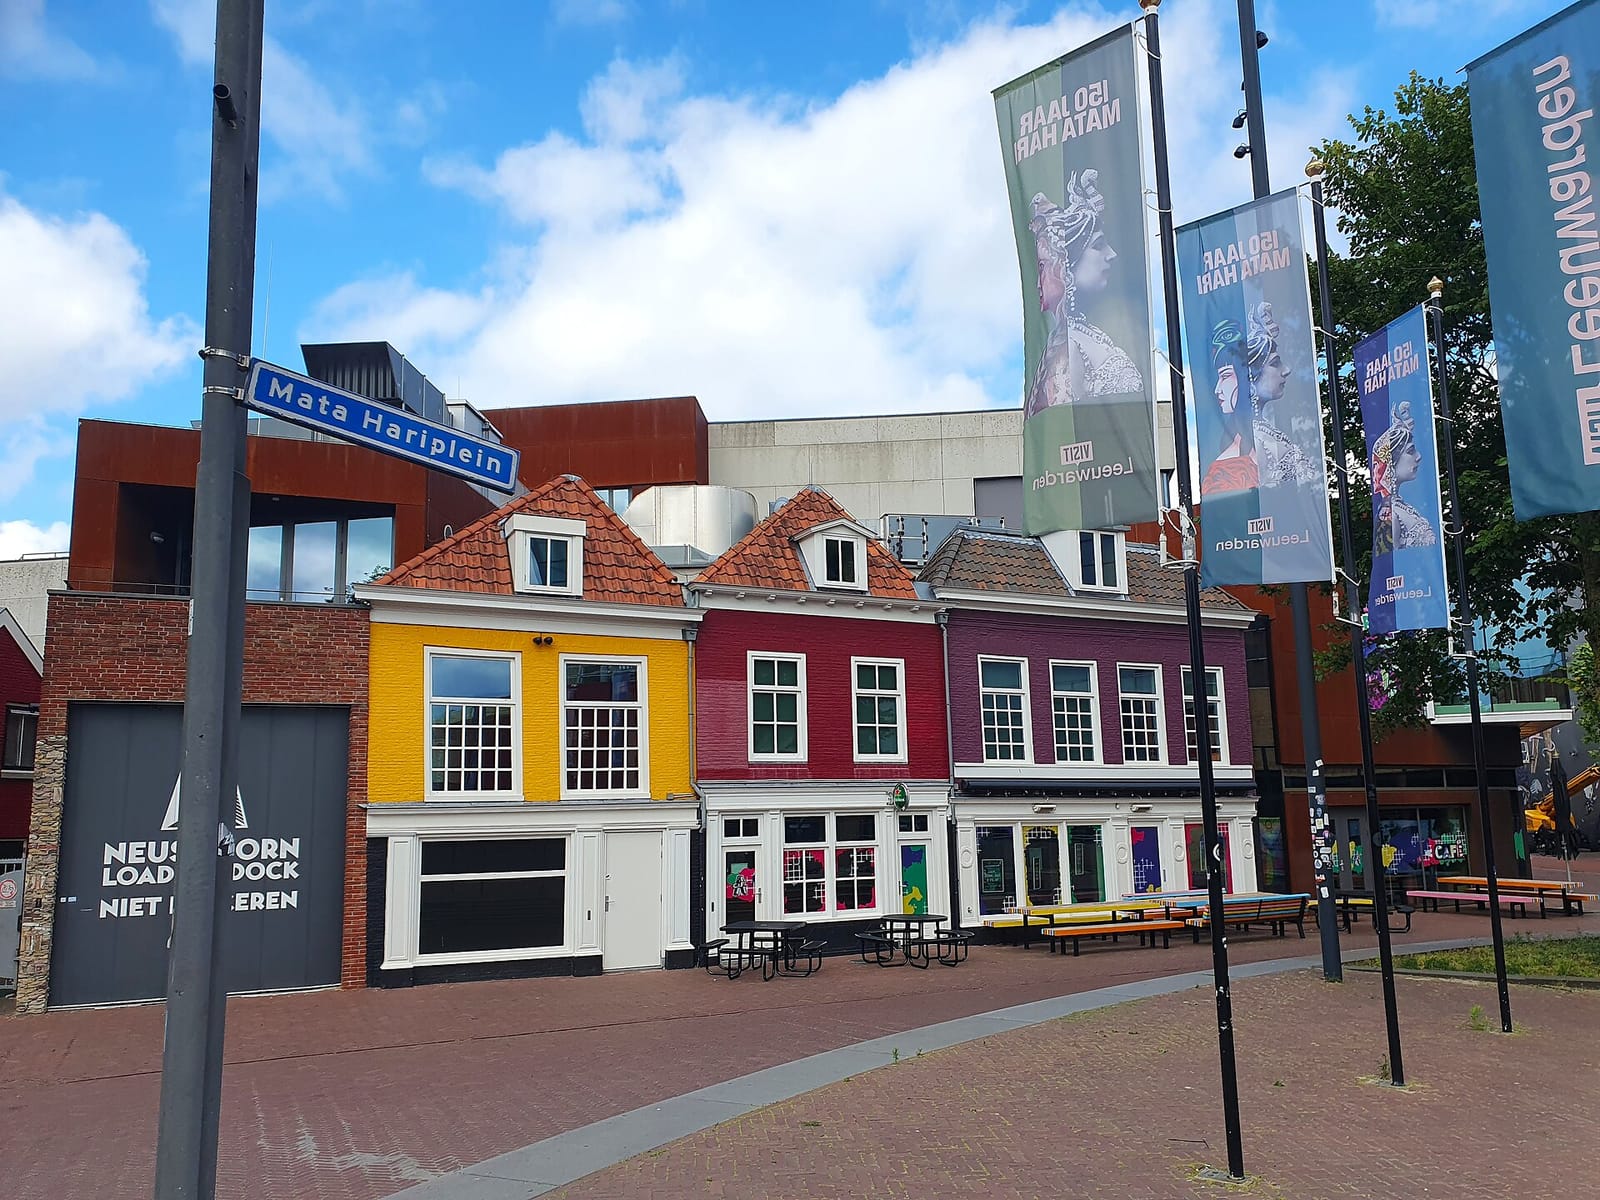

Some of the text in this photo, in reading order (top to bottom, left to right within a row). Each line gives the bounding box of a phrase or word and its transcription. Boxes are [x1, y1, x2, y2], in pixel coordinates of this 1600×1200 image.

[268, 377, 501, 474] Mata Hariplein
[102, 865, 175, 887] LOAD
[99, 896, 163, 919] NIET
